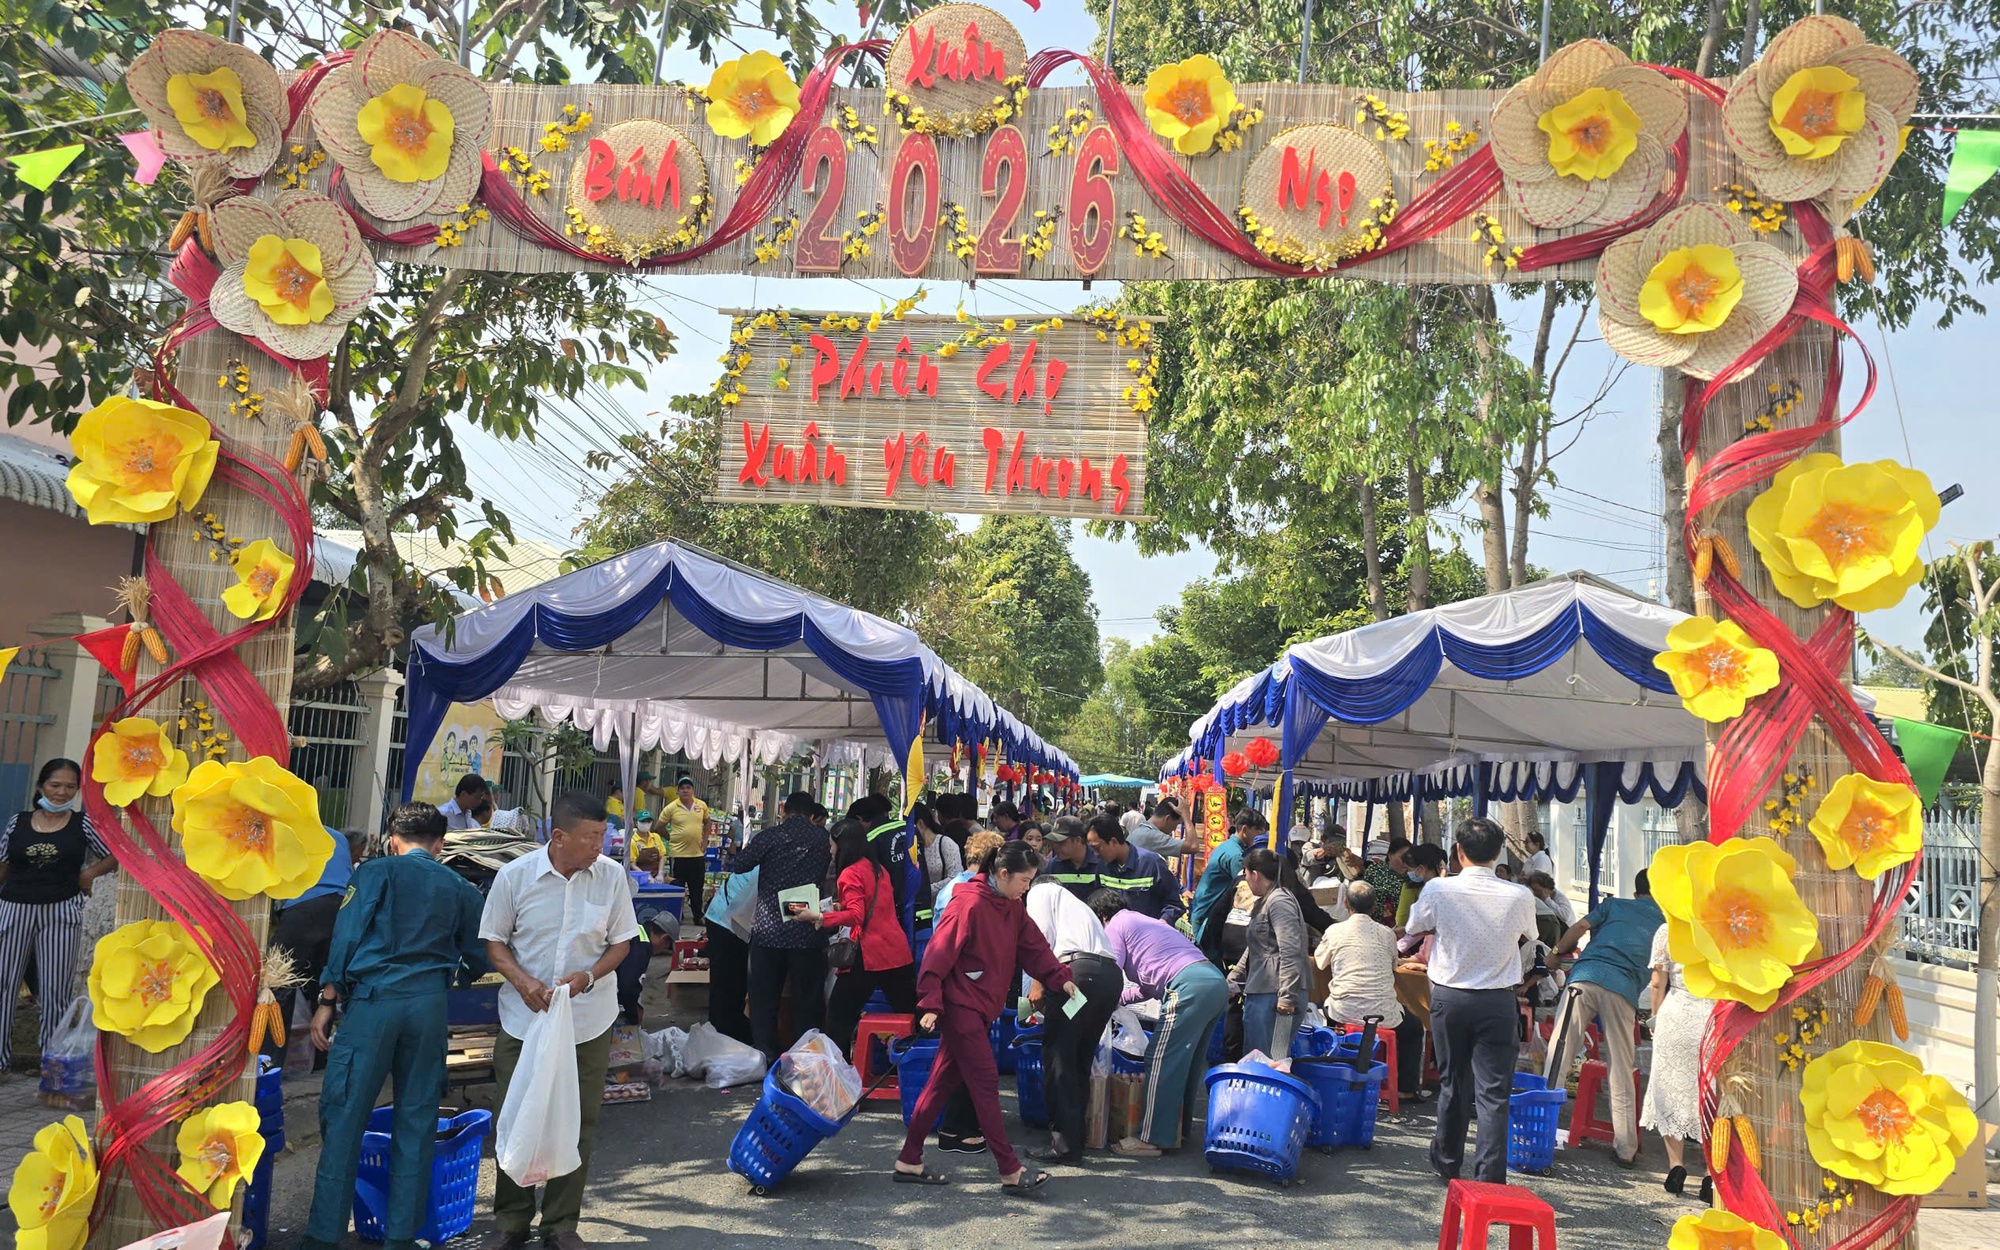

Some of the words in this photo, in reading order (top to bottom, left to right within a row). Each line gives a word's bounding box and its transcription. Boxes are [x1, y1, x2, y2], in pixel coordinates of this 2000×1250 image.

[904, 21, 1006, 88] Xuân
[584, 138, 681, 211] Bính
[795, 124, 1120, 276] 2026
[1277, 146, 1357, 229] Ngọ
[809, 334, 939, 403] Phiên
[975, 339, 1069, 416] Chợ
[737, 420, 847, 488] Xuân
[883, 431, 956, 498] Yêu
[982, 427, 1131, 515] Thương
